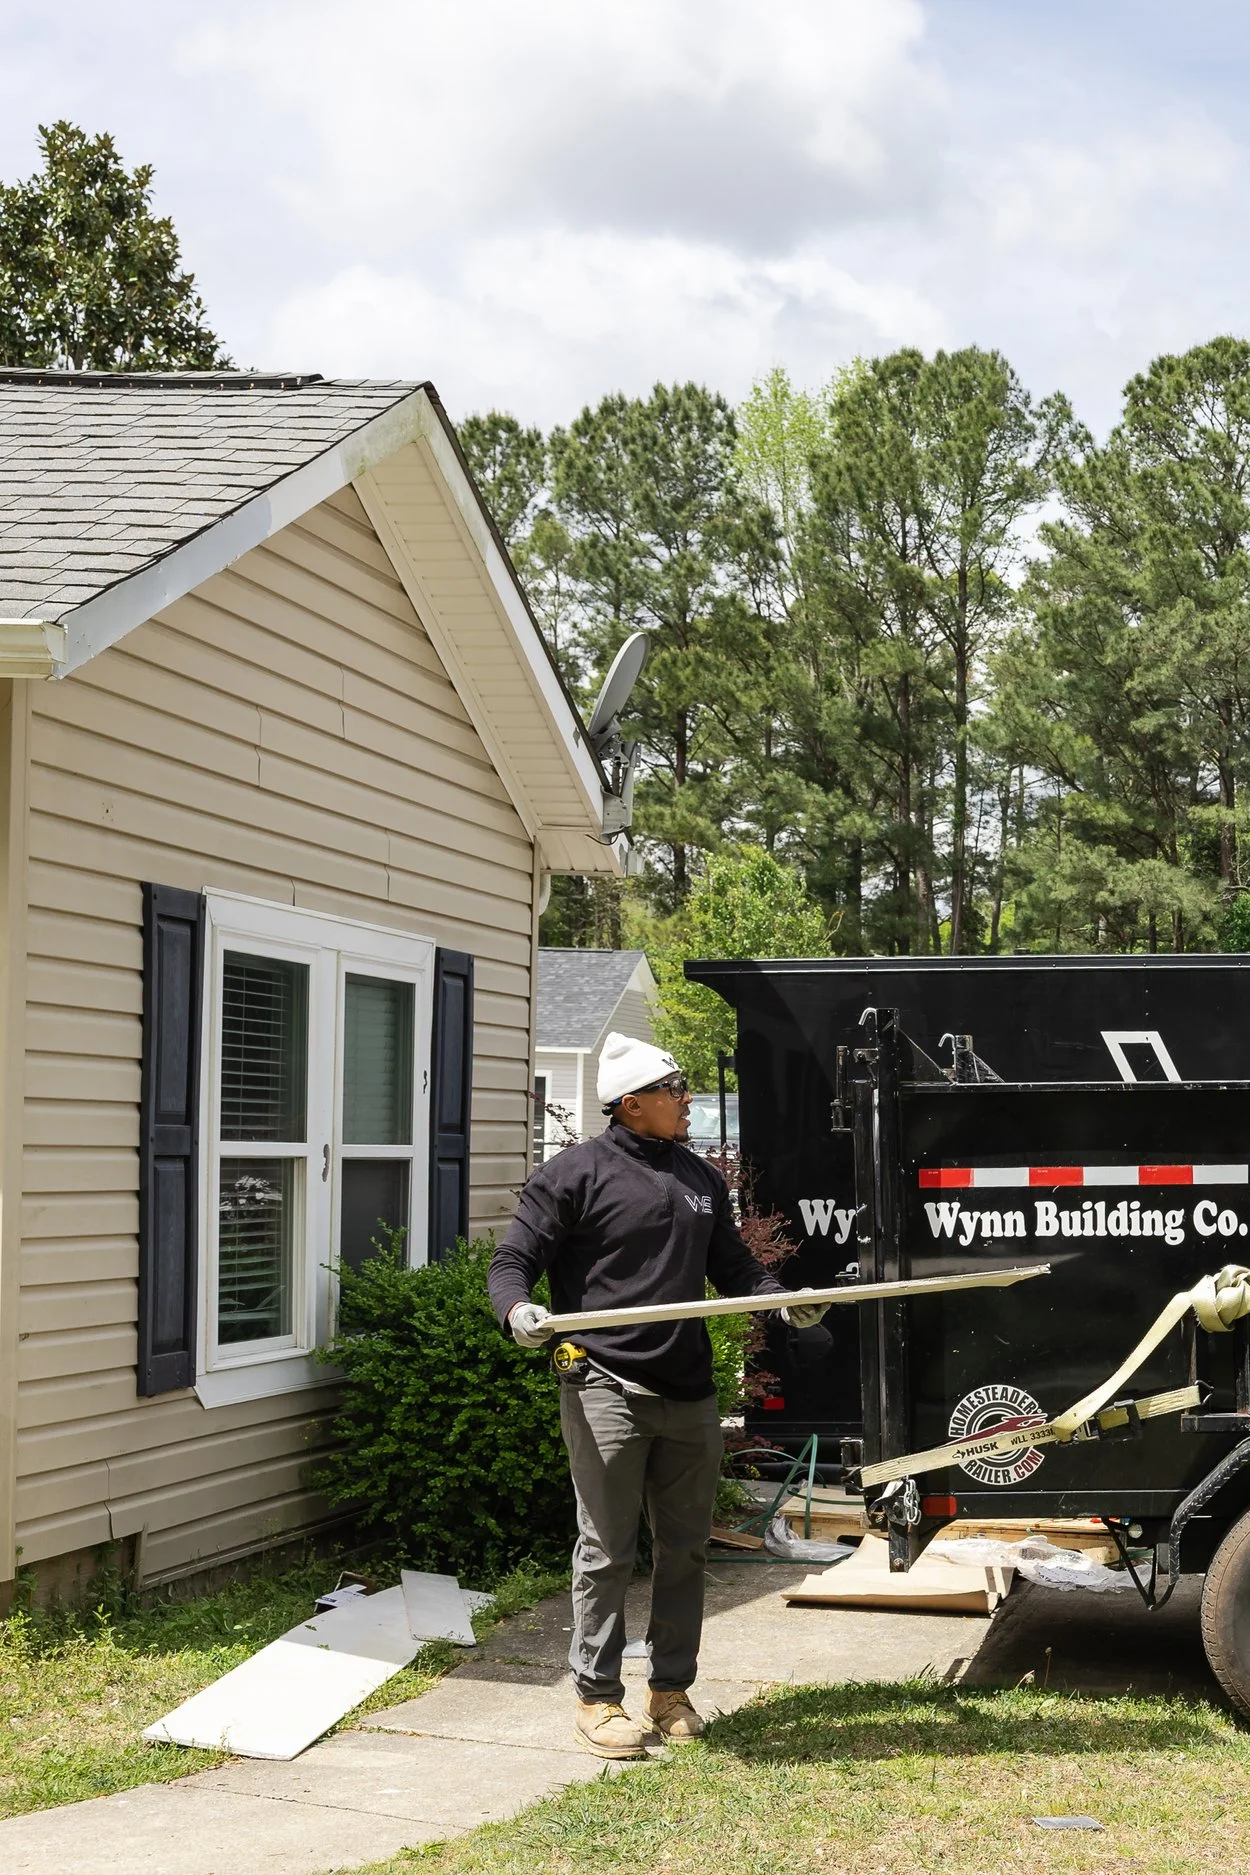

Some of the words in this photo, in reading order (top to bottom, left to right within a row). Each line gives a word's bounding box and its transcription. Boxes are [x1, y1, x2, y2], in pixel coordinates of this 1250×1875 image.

[798, 1199, 856, 1244] Wy
[924, 1201, 1027, 1246] Wynn
[1034, 1200, 1185, 1246] Building
[1193, 1200, 1248, 1237] Co.
[950, 1386, 1036, 1436] HOMESTEADER
[964, 1449, 1043, 1484] RAILER.COM
[966, 1441, 999, 1458] HUSK
[1010, 1434, 1028, 1446] WLL
